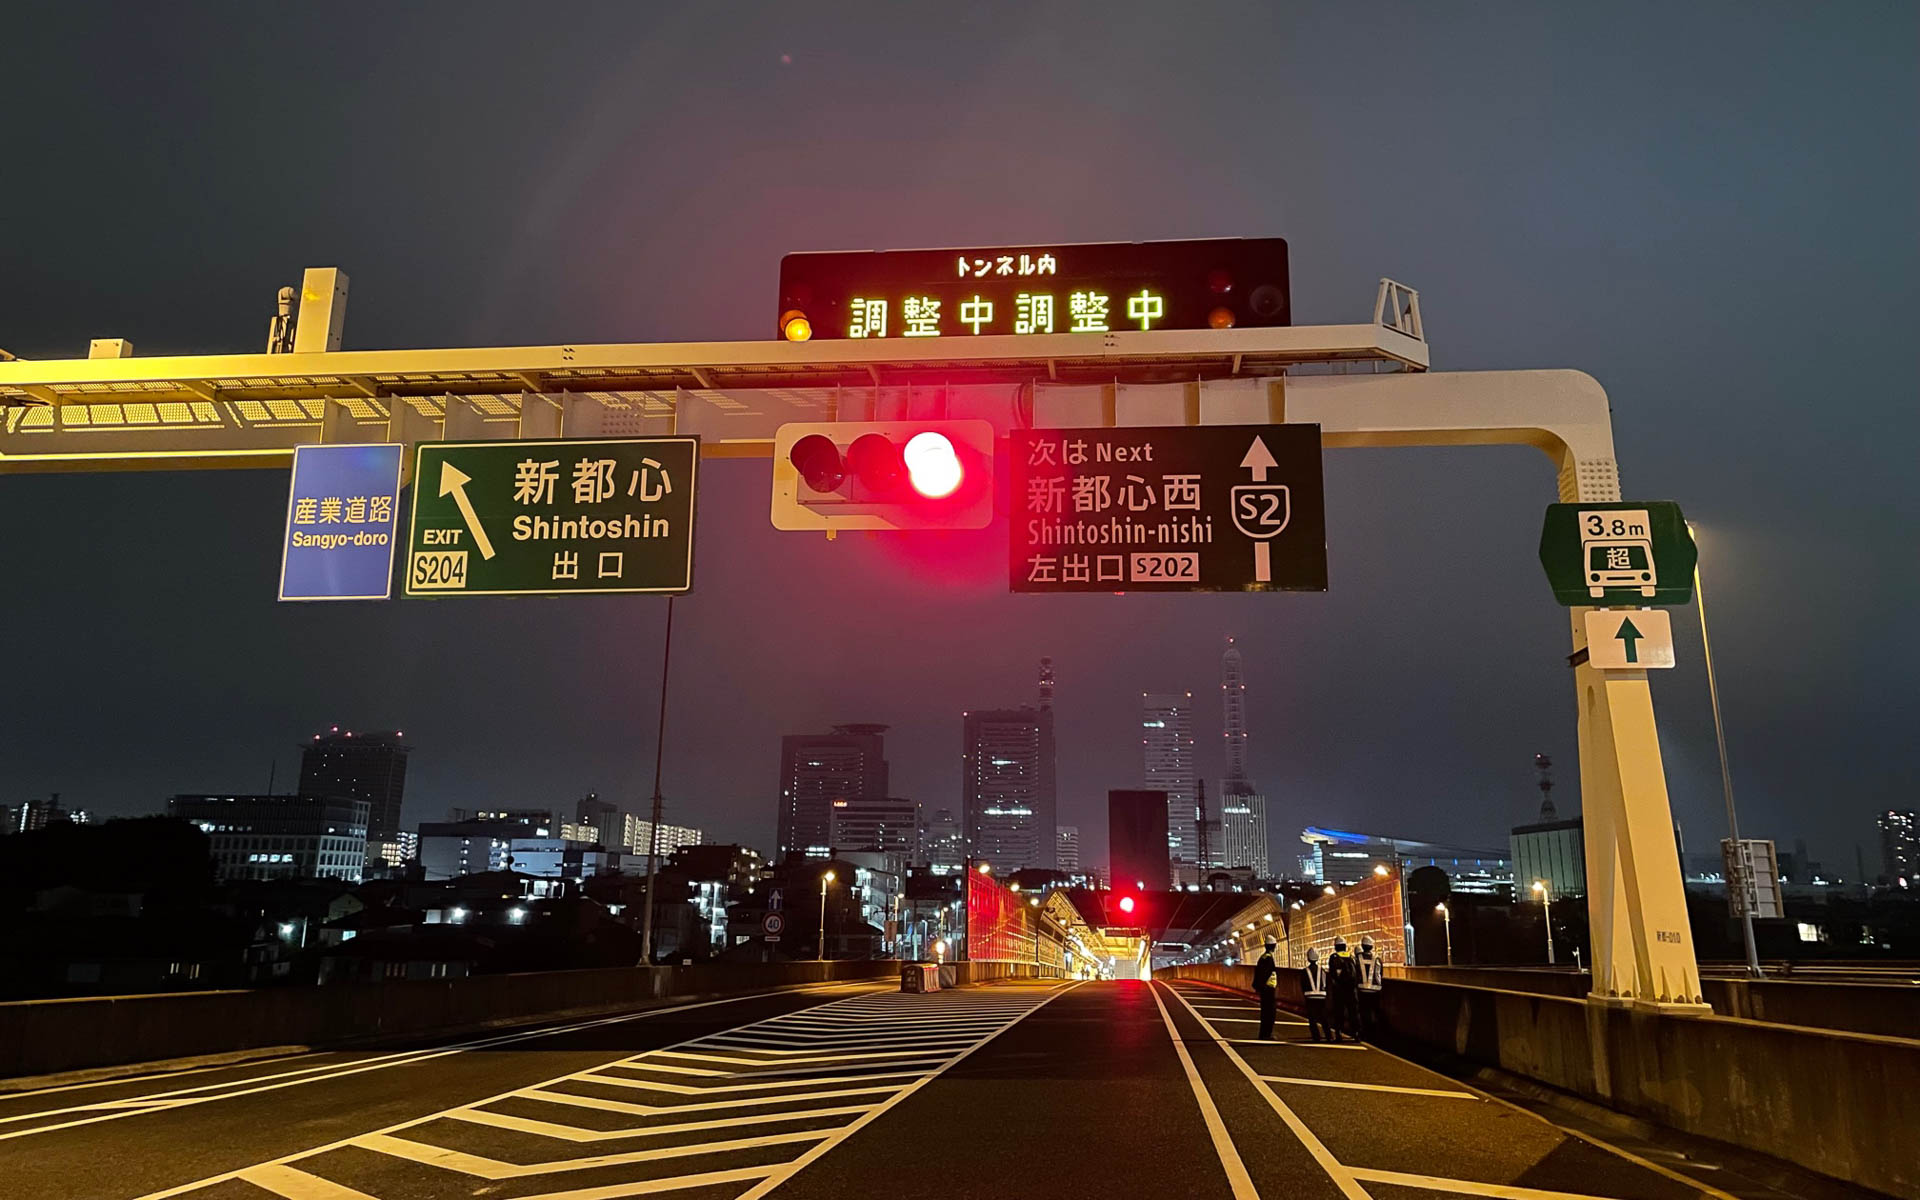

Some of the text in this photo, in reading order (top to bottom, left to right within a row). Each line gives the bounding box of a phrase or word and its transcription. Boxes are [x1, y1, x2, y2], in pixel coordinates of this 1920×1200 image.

[958, 254, 1056, 277] トンネル内
[849, 289, 1163, 338] 調整中調整中
[1028, 439, 1153, 466] 次は Next
[513, 457, 672, 506] 新都心
[1028, 474, 1201, 513] 新都心西
[294, 496, 392, 525] 産業道路
[1240, 494, 1280, 525] S2
[292, 530, 388, 549] Sangyo-doro
[423, 529, 463, 546] EXIT
[512, 514, 669, 541] Shintoshin
[1028, 515, 1212, 545] Shintoshin-nishi
[415, 554, 465, 587] S204
[552, 551, 623, 580] 出口
[1027, 552, 1194, 582] 左出口 S202
[1607, 547, 1632, 569] 超
[767, 919, 780, 929] 40
